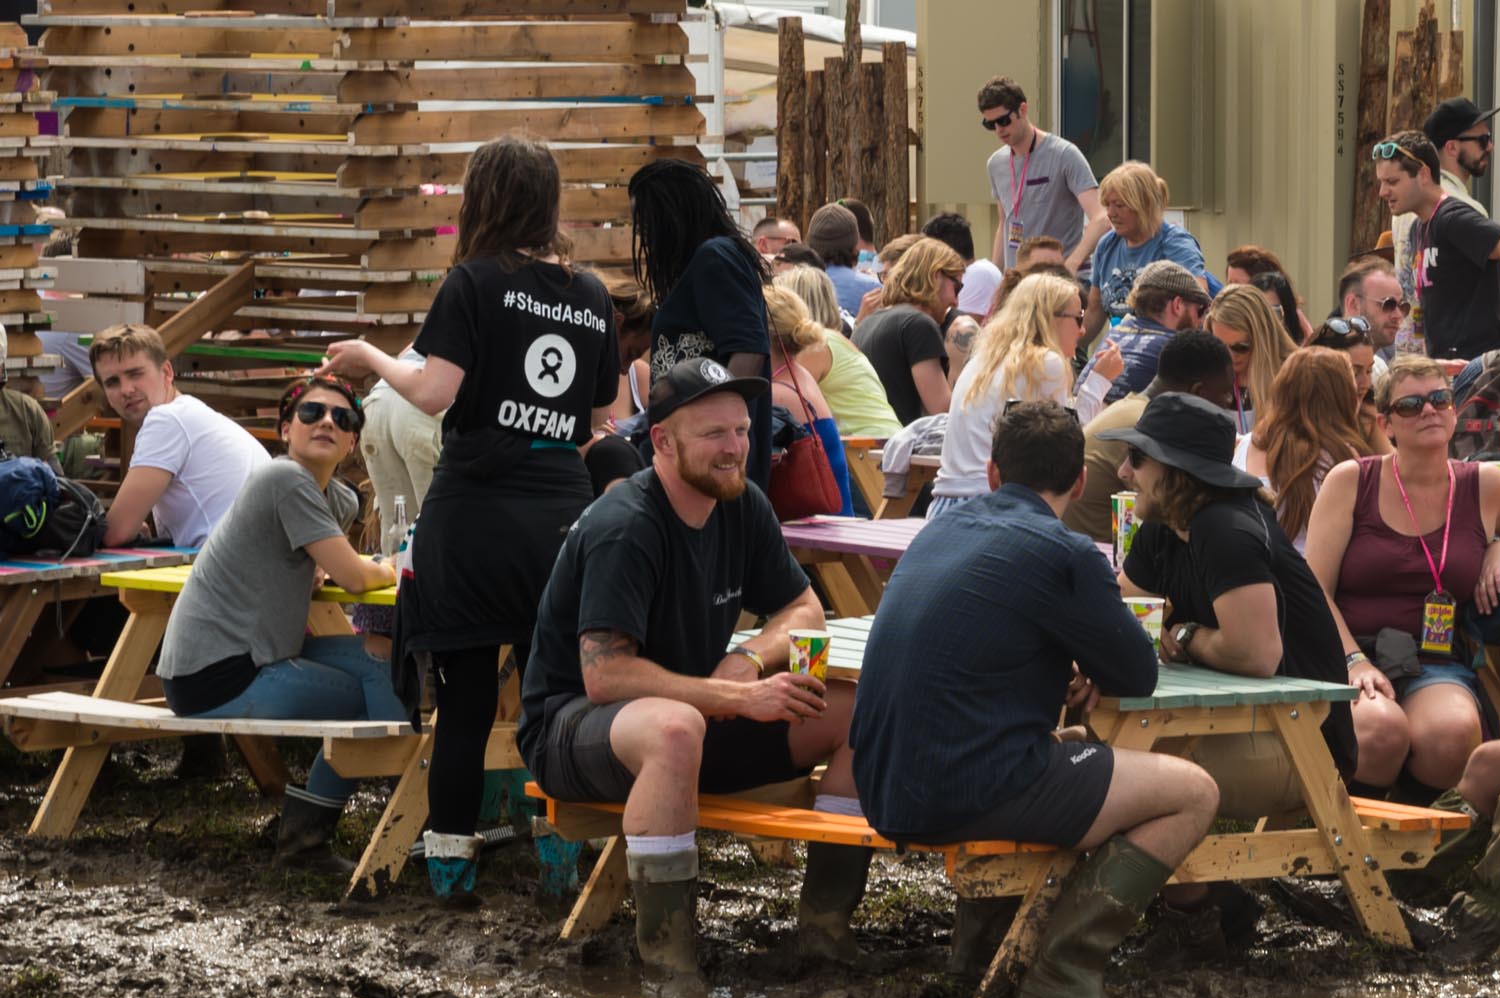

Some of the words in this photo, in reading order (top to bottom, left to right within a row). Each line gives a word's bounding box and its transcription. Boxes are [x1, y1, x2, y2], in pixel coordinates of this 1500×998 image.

[1337, 63, 1345, 157] SS7594
[503, 290, 606, 333] #StandAsOne
[498, 400, 576, 441] OXFAM
